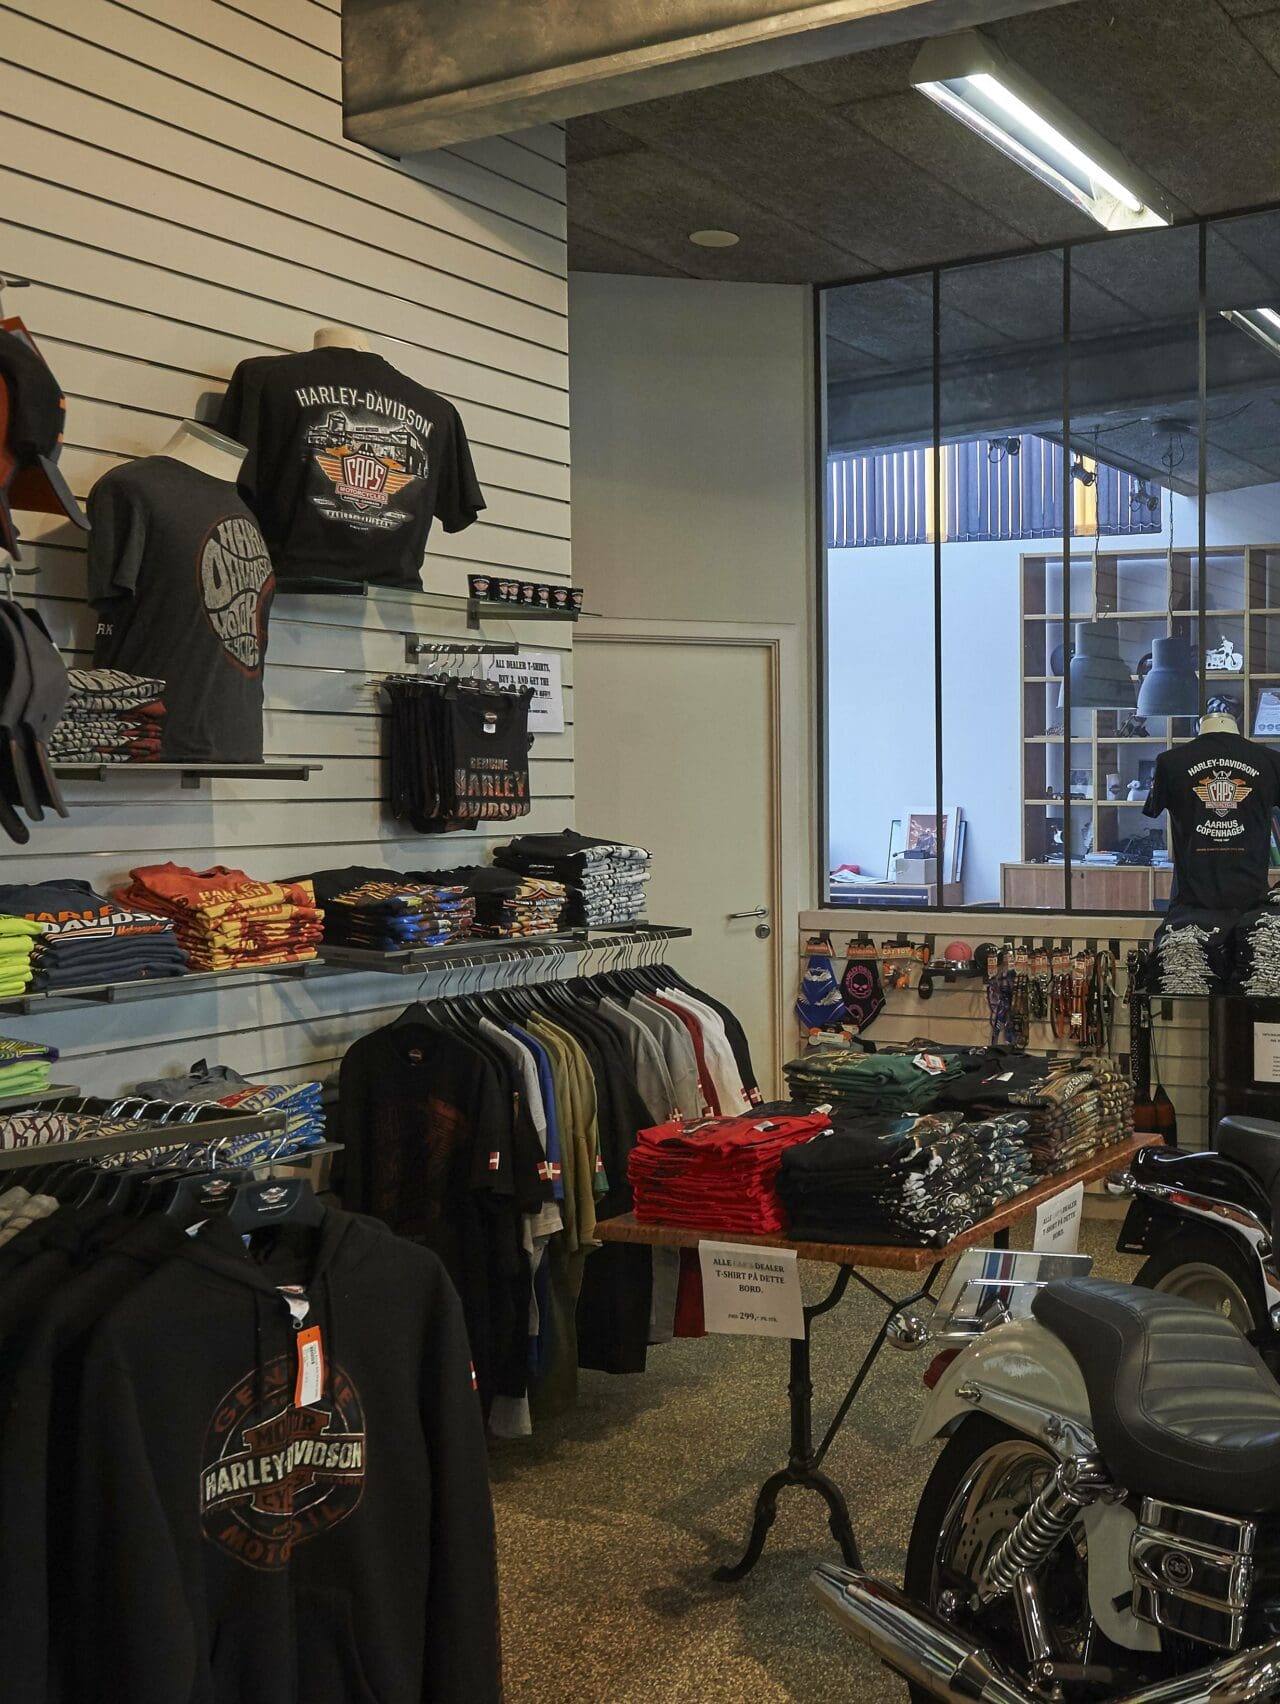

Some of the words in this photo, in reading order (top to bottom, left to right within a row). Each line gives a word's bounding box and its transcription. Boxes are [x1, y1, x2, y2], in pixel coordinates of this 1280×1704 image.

[295, 385, 433, 438] HARLEY-DAVIDSON
[346, 457, 384, 491] CAPS
[495, 659, 506, 669] ALL
[506, 660, 527, 671] DEALER
[498, 674, 510, 684] BUY
[517, 675, 529, 685] AND
[529, 676, 541, 686] GET
[541, 677, 550, 686] THE
[454, 768, 528, 797] HARLEY
[1209, 781, 1235, 802] CAPS
[1195, 823, 1245, 838] COPENHAGEN
[1204, 819, 1239, 829] AARHUS
[712, 1258, 733, 1267] ALLE
[754, 1262, 785, 1273] DEALER
[715, 1269, 747, 1280] T-SHIRT
[747, 1271, 759, 1282] PÅ
[759, 1275, 785, 1285] DETTE
[738, 1284, 764, 1294] BORD.
